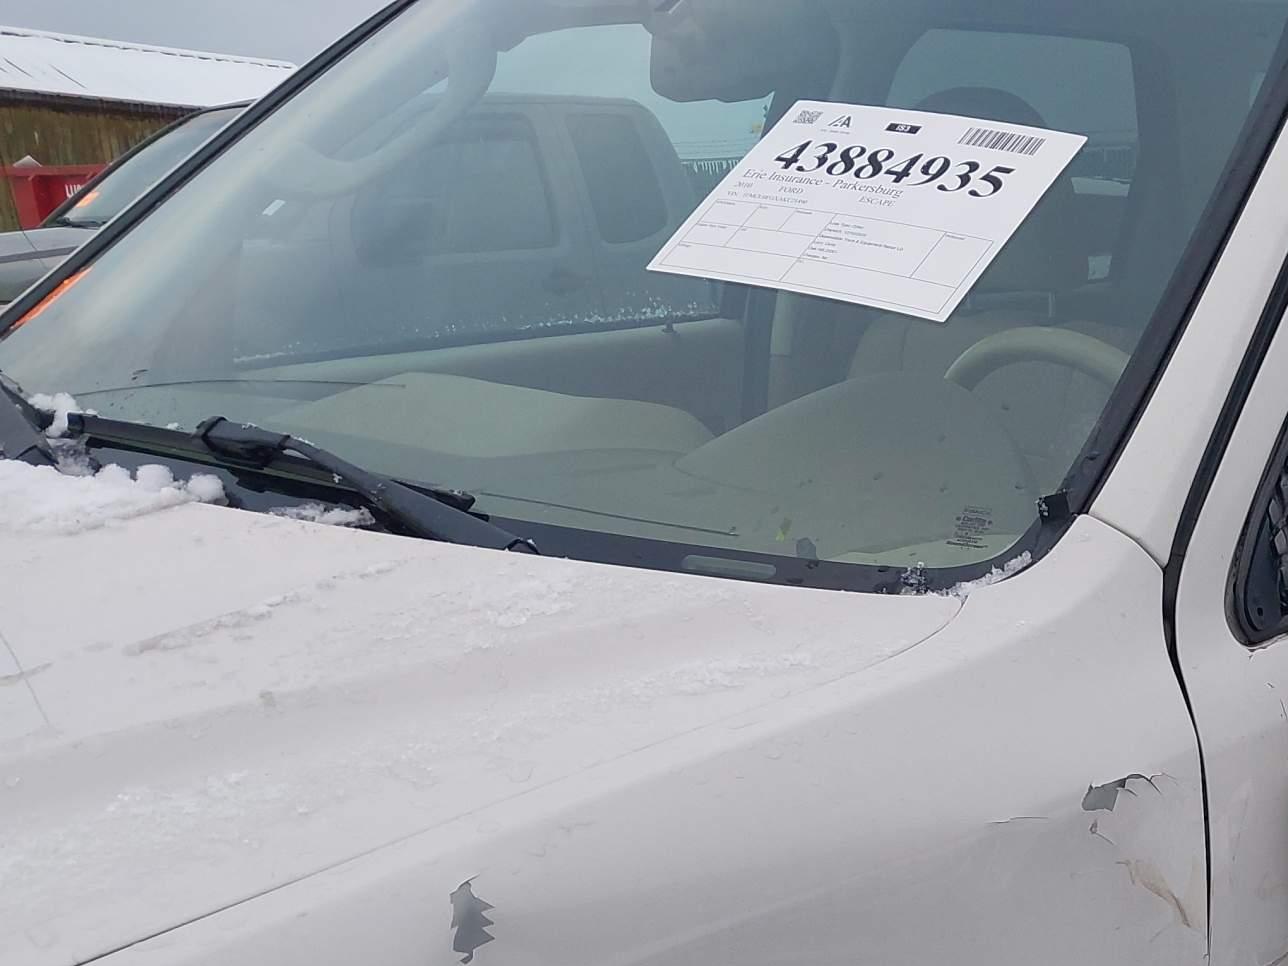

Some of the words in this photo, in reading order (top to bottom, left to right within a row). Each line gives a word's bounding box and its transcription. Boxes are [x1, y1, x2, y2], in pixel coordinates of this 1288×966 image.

[774, 139, 1016, 200] 43884935
[743, 169, 768, 180] Erie
[768, 171, 824, 187] Insurance
[832, 178, 904, 199] Parkersburg
[778, 186, 804, 194] FORD
[858, 195, 896, 207] ESCAPE
